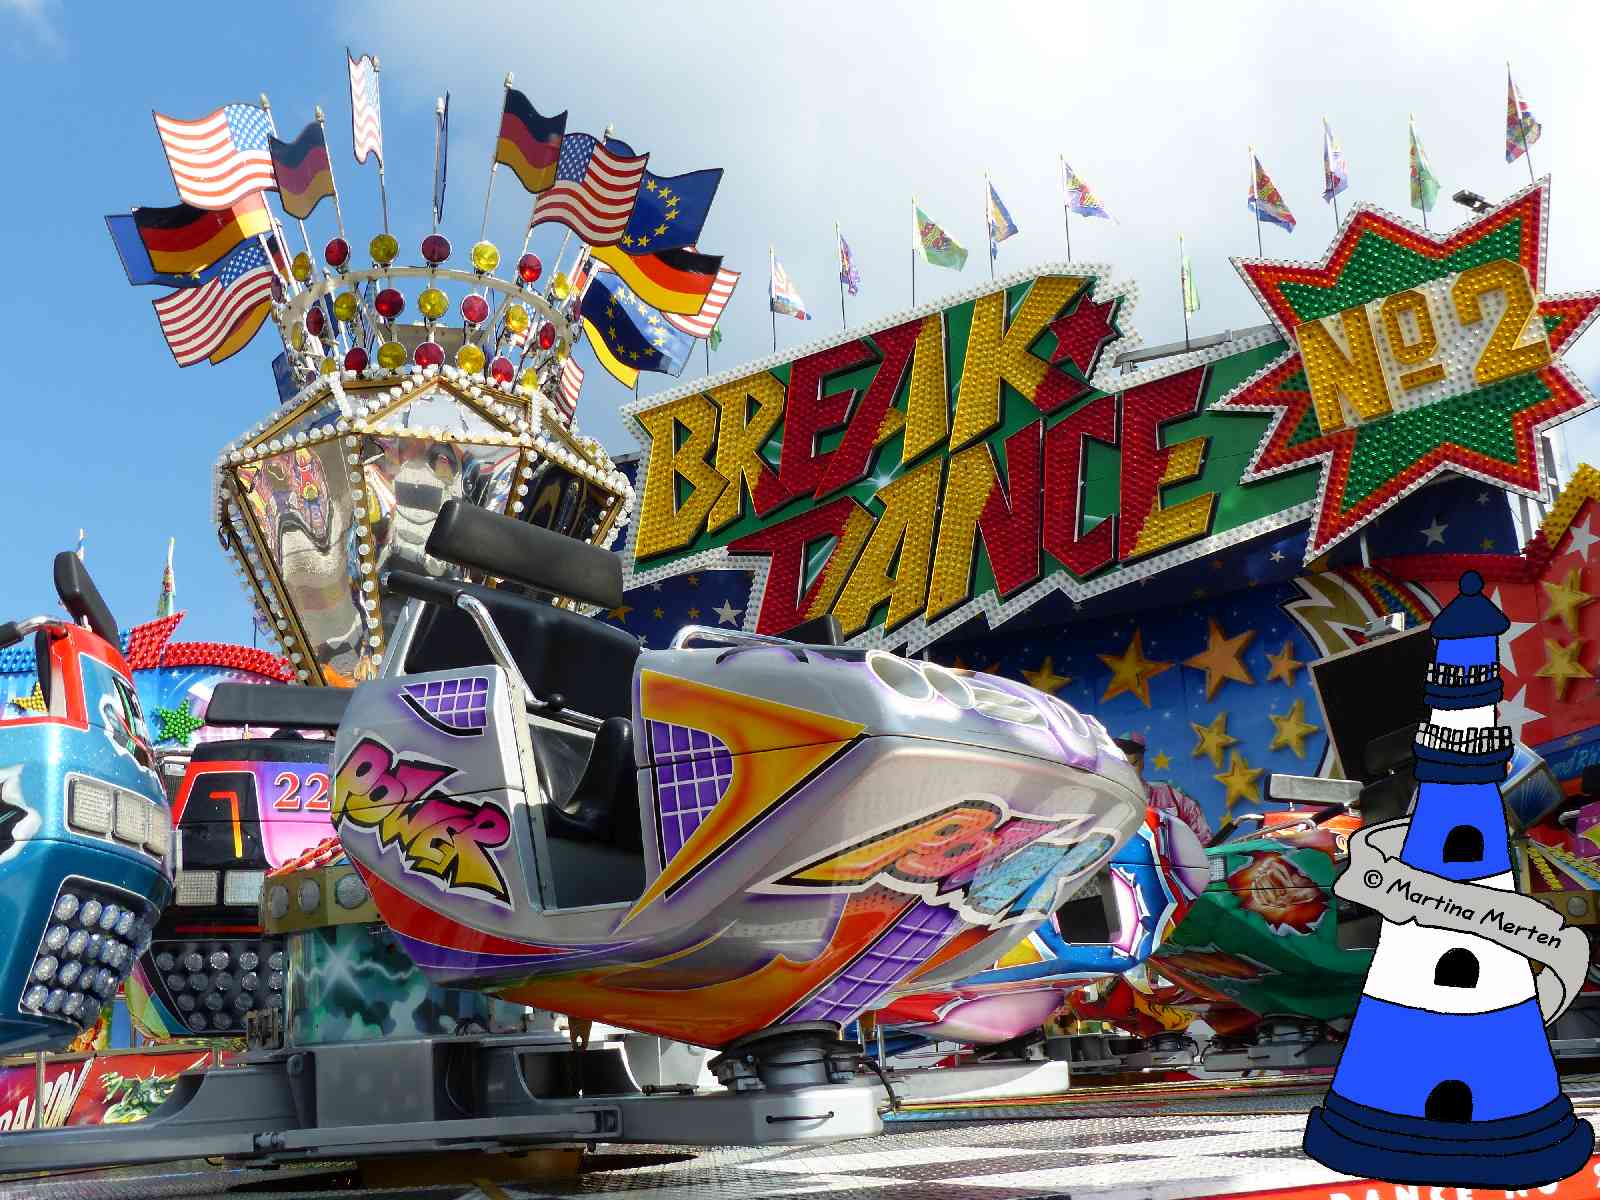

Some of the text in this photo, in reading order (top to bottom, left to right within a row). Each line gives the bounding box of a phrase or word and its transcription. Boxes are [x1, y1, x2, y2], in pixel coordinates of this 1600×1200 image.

[1451, 258, 1552, 387] 2
[633, 274, 1094, 561] BREAK
[727, 365, 1221, 635] DANCE
[272, 771, 331, 811] 22
[331, 737, 512, 905] POWER
